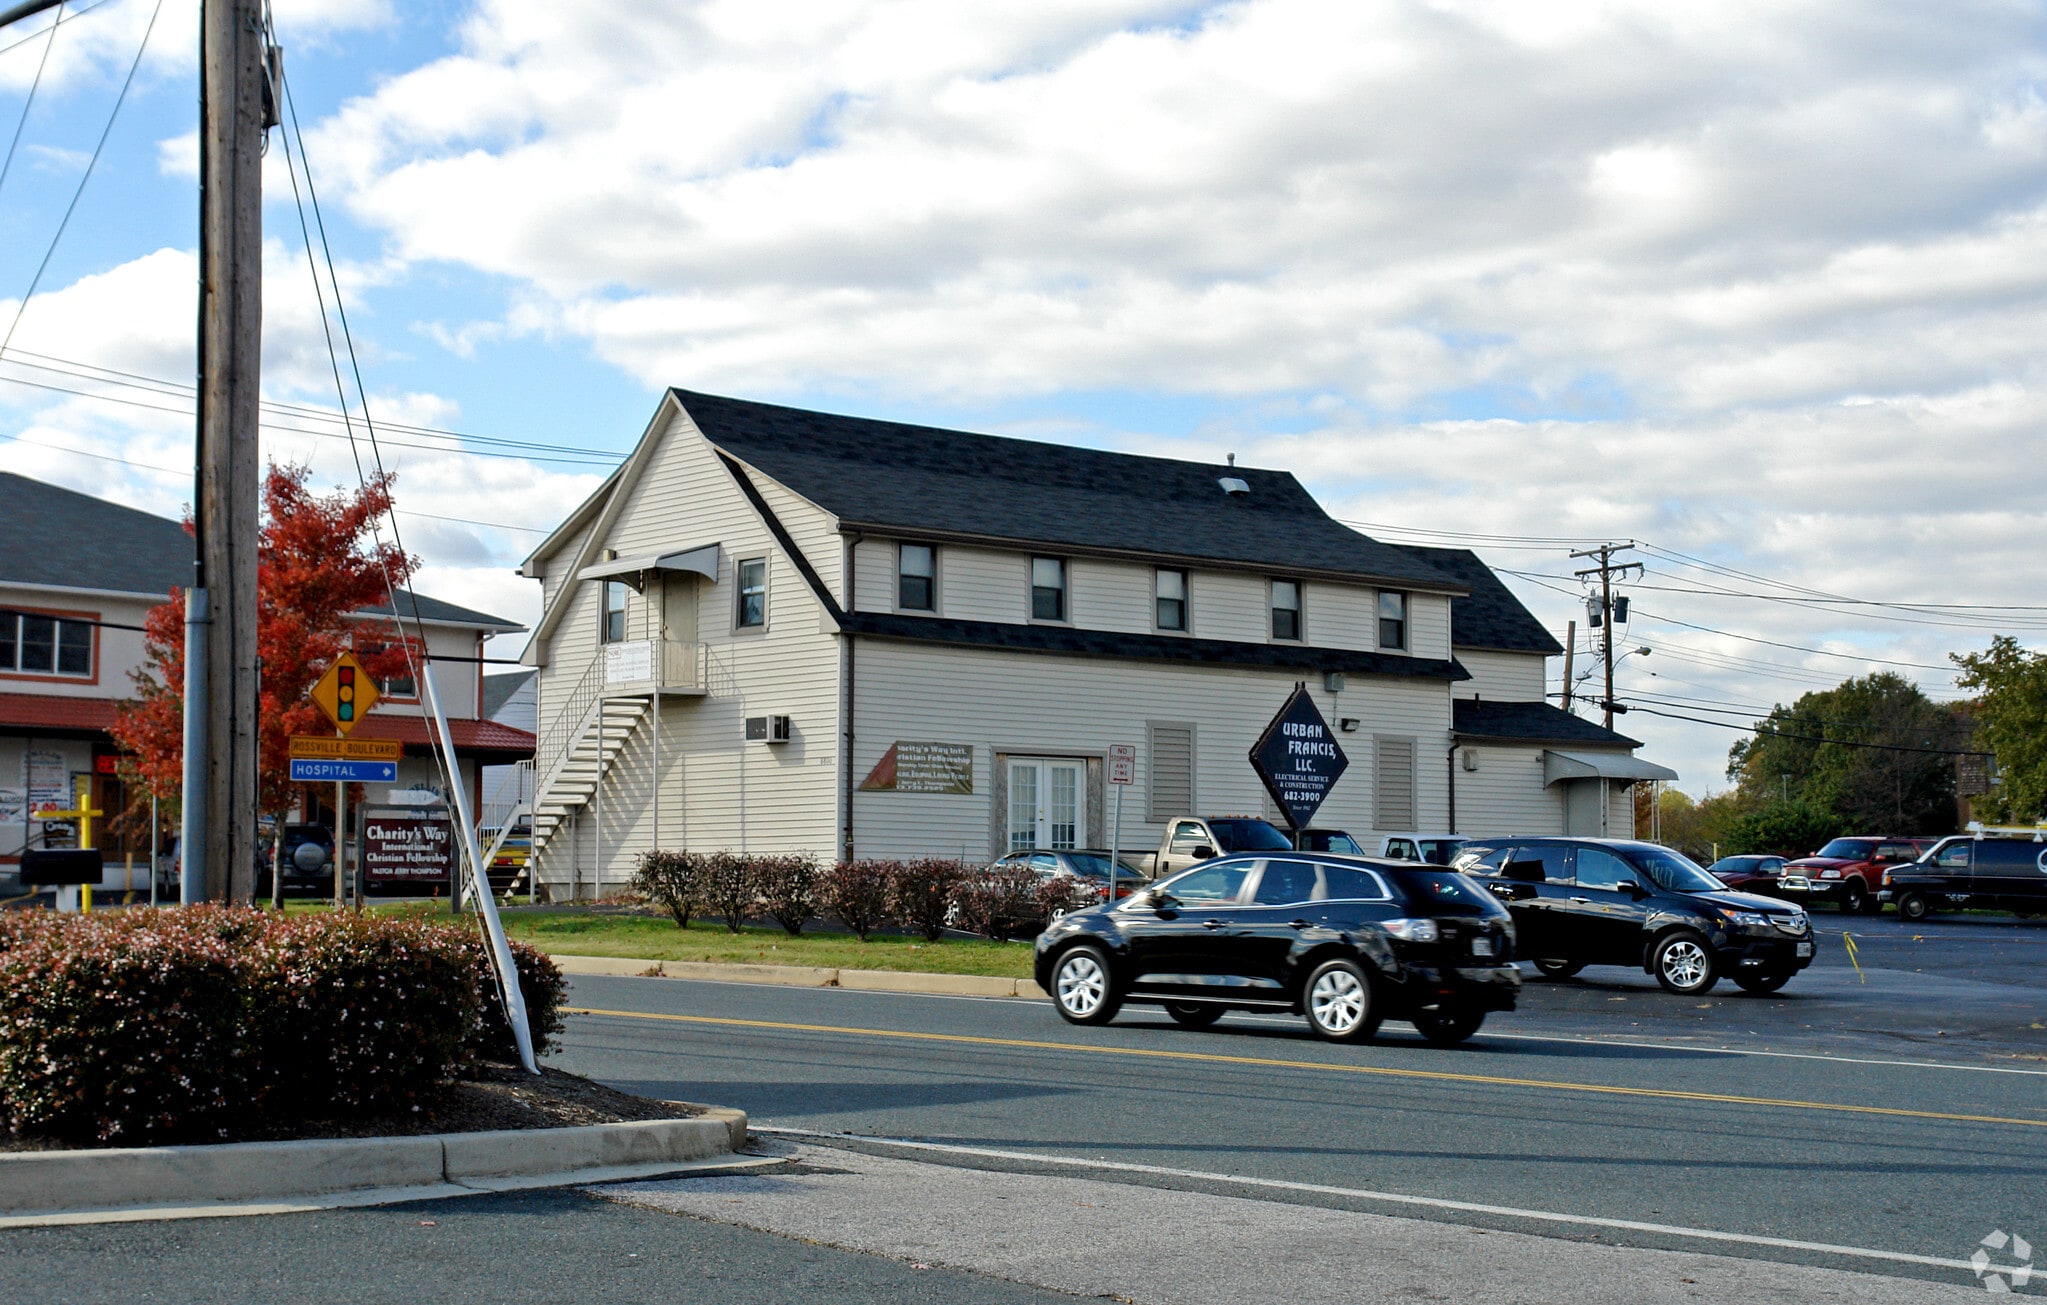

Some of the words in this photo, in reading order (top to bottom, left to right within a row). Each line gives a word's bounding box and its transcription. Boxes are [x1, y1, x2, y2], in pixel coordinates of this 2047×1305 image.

[1283, 723, 1322, 738] URBAN
[293, 741, 340, 753] ROSSVILLE
[347, 743, 396, 755] BOULEVARD
[1289, 741, 1336, 759] FRANCIS,
[296, 764, 356, 776] HOSPITAL
[1295, 758, 1316, 772] LLC.
[1275, 773, 1306, 781] ELECTRICAL
[1284, 790, 1320, 802] 682-3900
[367, 826, 421, 843] Charity's
[423, 826, 448, 844] Way
[382, 842, 434, 850] International
[366, 852, 404, 862] Christian
[406, 852, 448, 865] Fellowship
